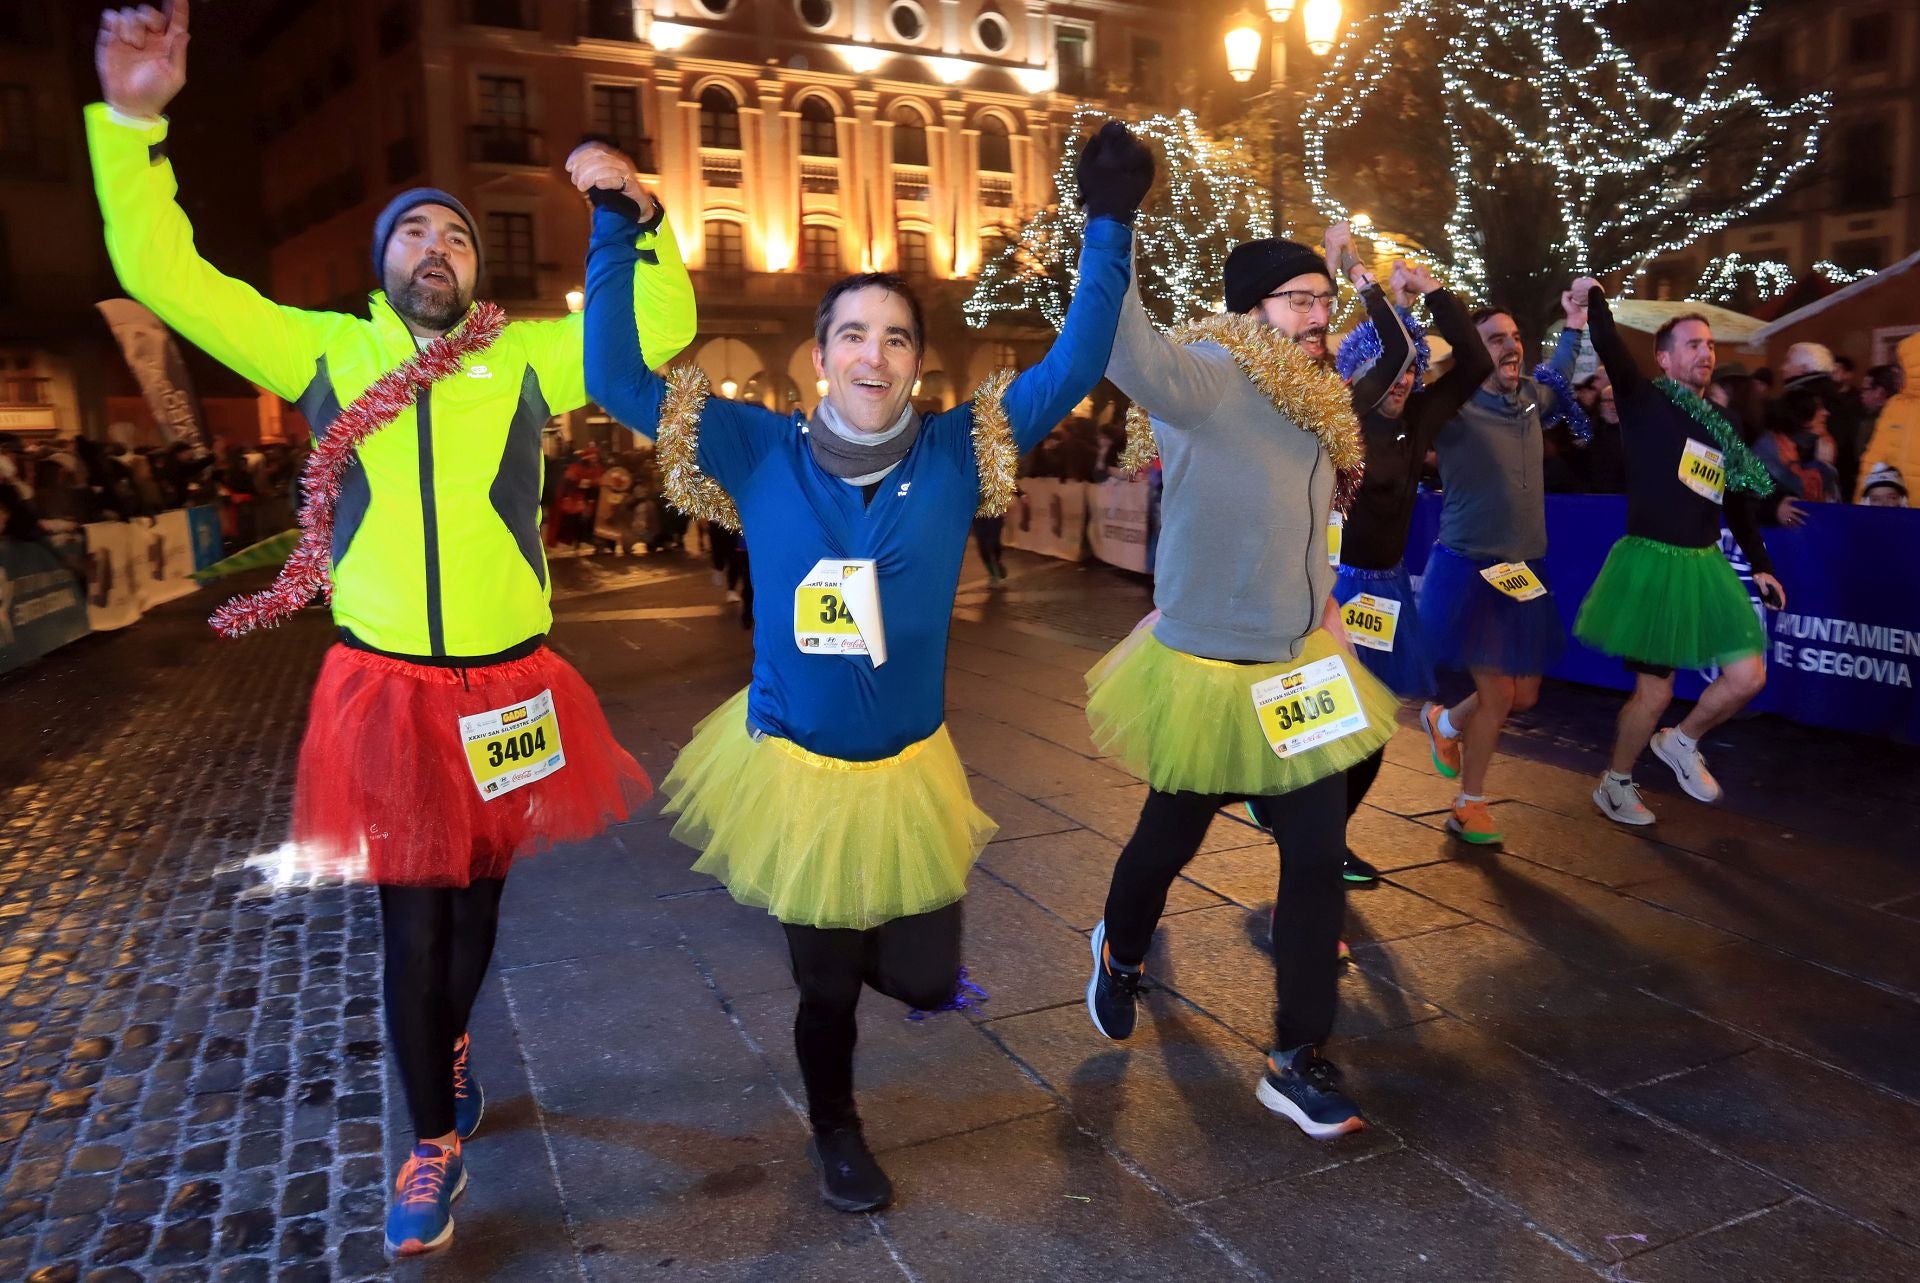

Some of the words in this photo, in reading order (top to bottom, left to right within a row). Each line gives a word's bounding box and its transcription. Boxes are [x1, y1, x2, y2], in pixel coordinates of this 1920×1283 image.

[1691, 460, 1720, 485] 3401
[1499, 574, 1529, 591] 3400
[1346, 609, 1382, 632] 3405
[1798, 647, 1913, 688] SEGOVIA
[502, 707, 527, 723] GADIS
[1275, 689, 1335, 730] 3406
[468, 732, 487, 741] XXXIV
[501, 720, 530, 733] SILVESTRE
[487, 726, 546, 767] 3404
